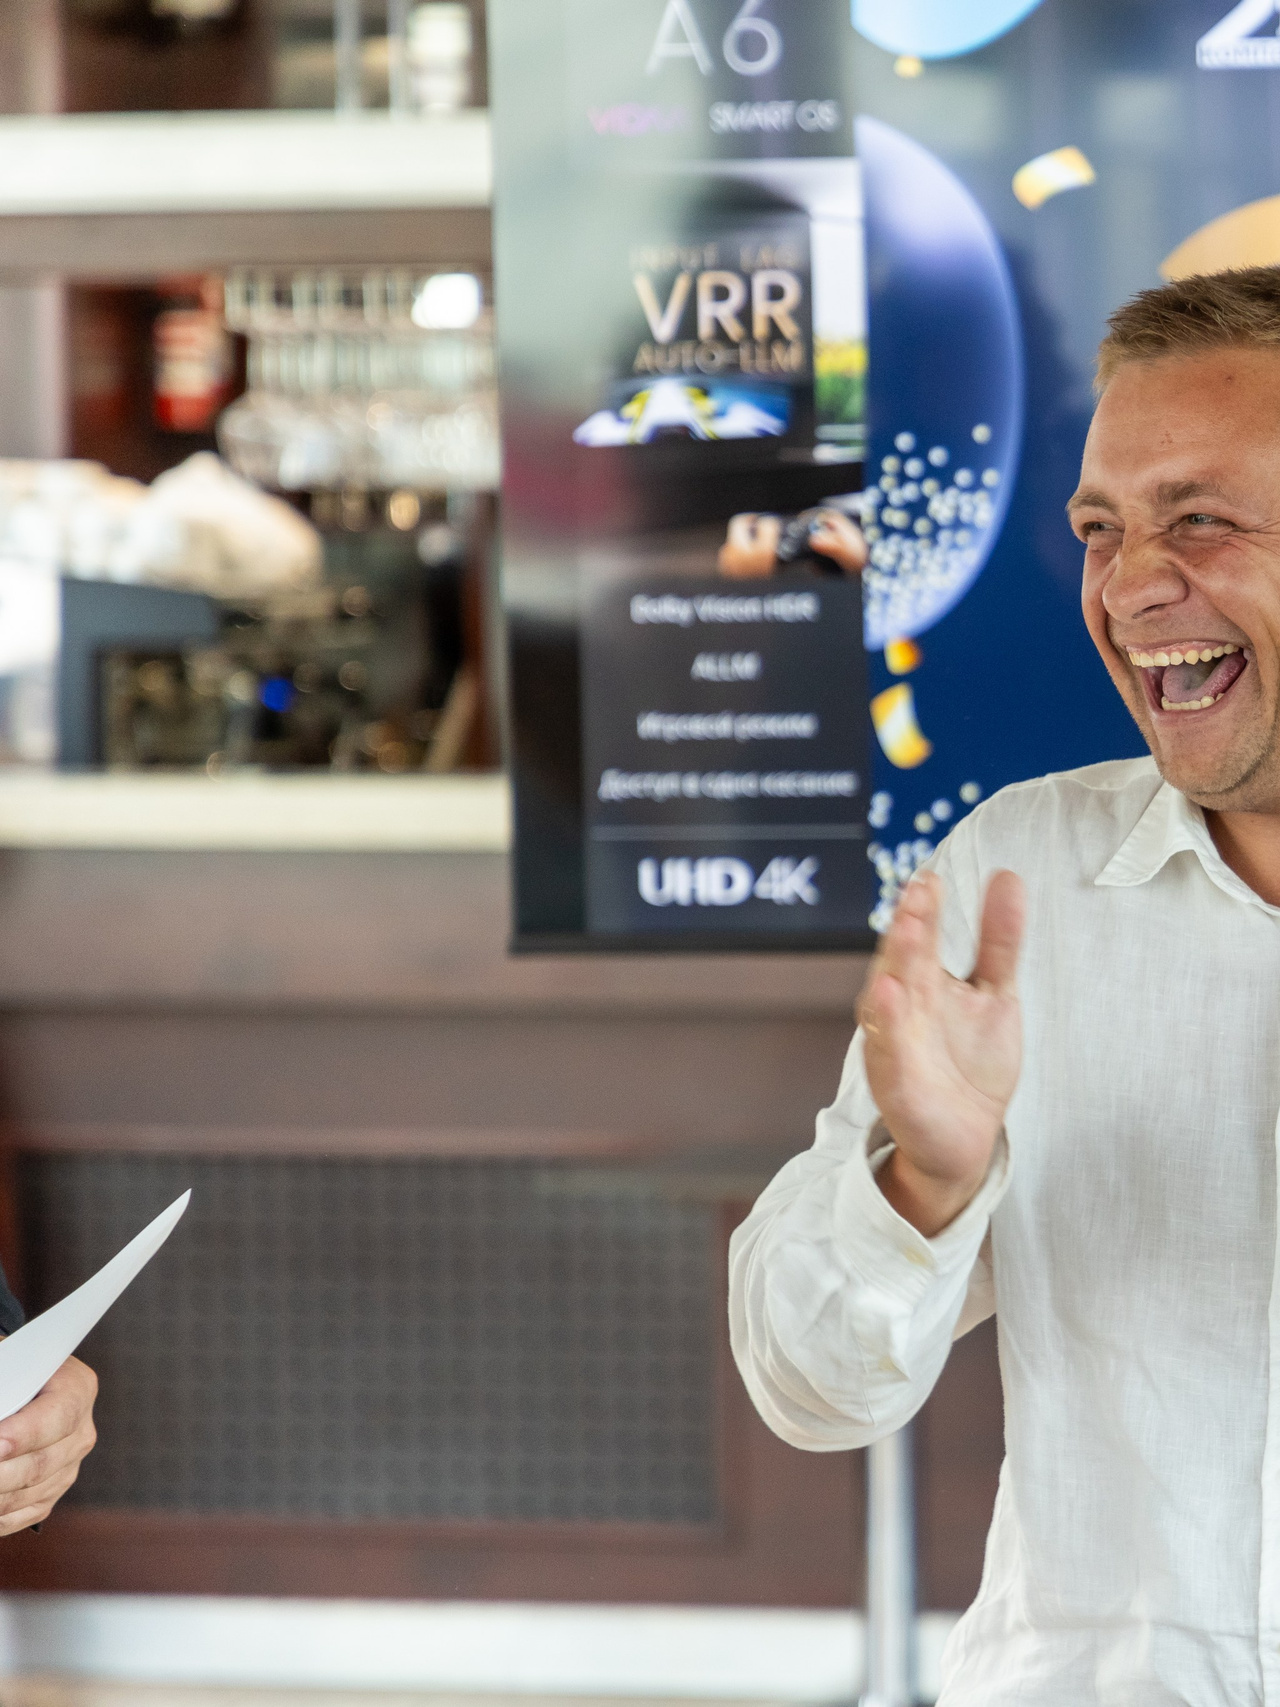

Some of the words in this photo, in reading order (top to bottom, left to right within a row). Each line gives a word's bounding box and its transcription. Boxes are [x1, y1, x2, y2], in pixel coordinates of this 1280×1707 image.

[709, 101, 795, 133] SMART
[796, 100, 843, 132] OS
[633, 269, 802, 343] VRR
[638, 857, 752, 906] UHD
[753, 857, 820, 905] 4K
